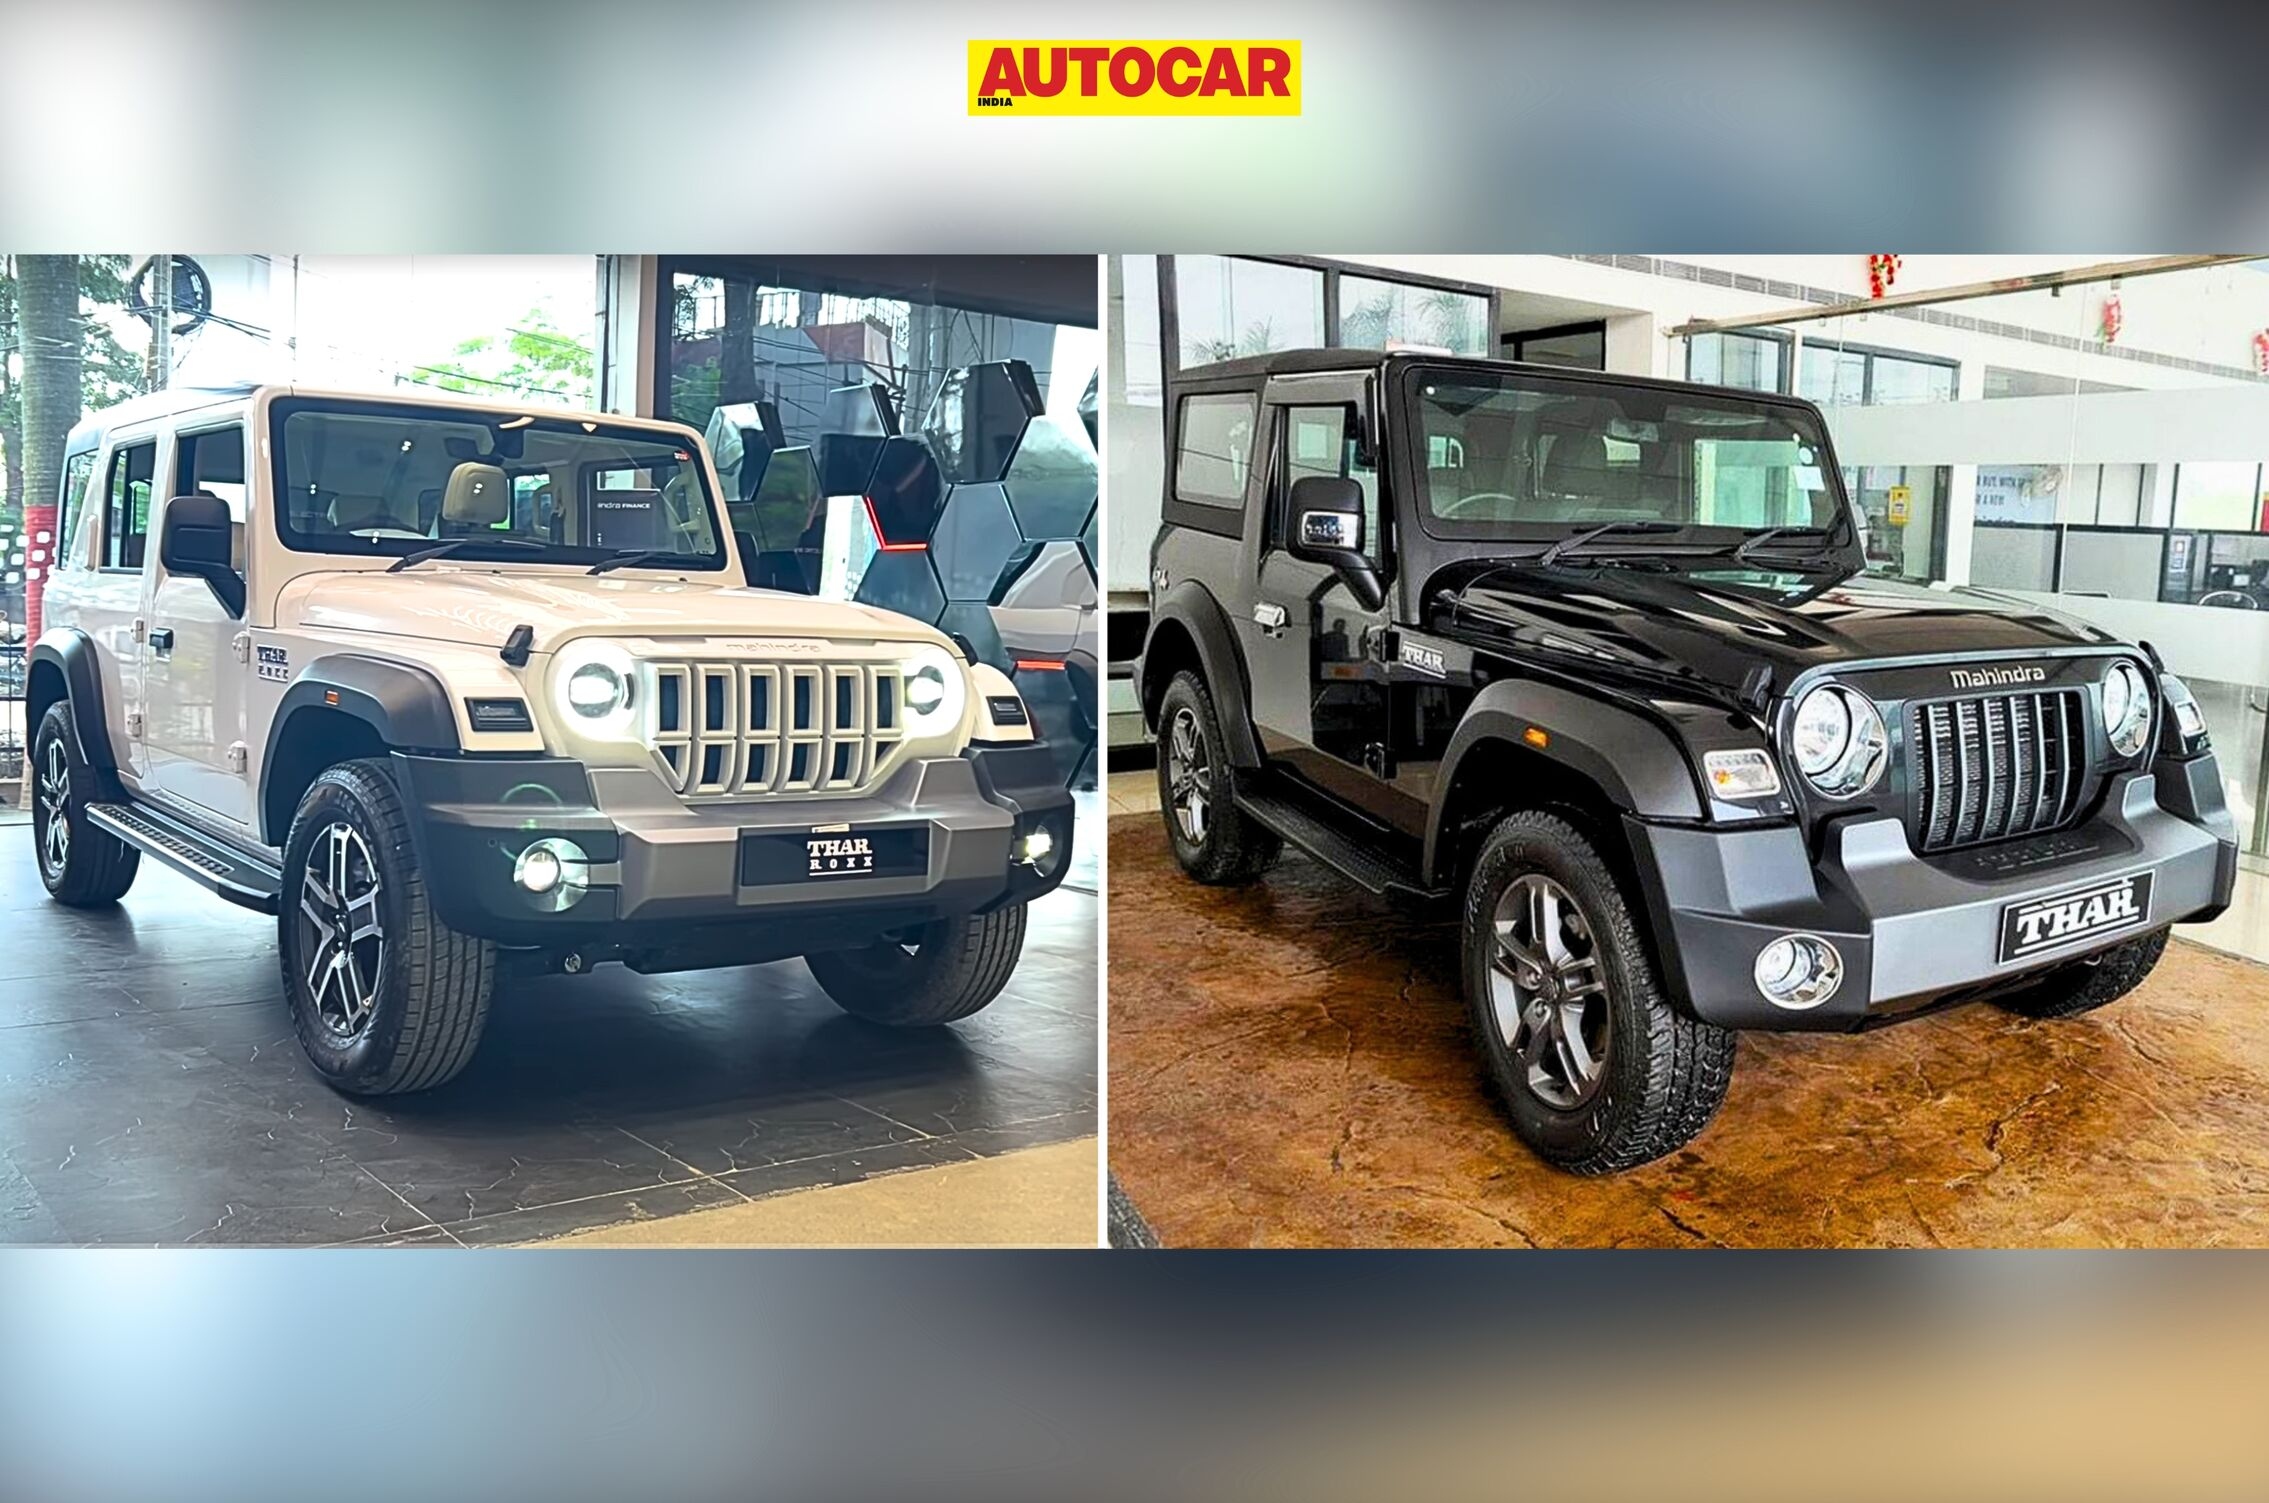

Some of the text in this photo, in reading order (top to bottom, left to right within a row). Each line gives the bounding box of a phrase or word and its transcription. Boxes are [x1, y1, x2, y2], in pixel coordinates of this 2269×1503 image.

[1402, 645, 1446, 674] THAR
[807, 838, 873, 857] THAR
[809, 856, 872, 870] ROXX
